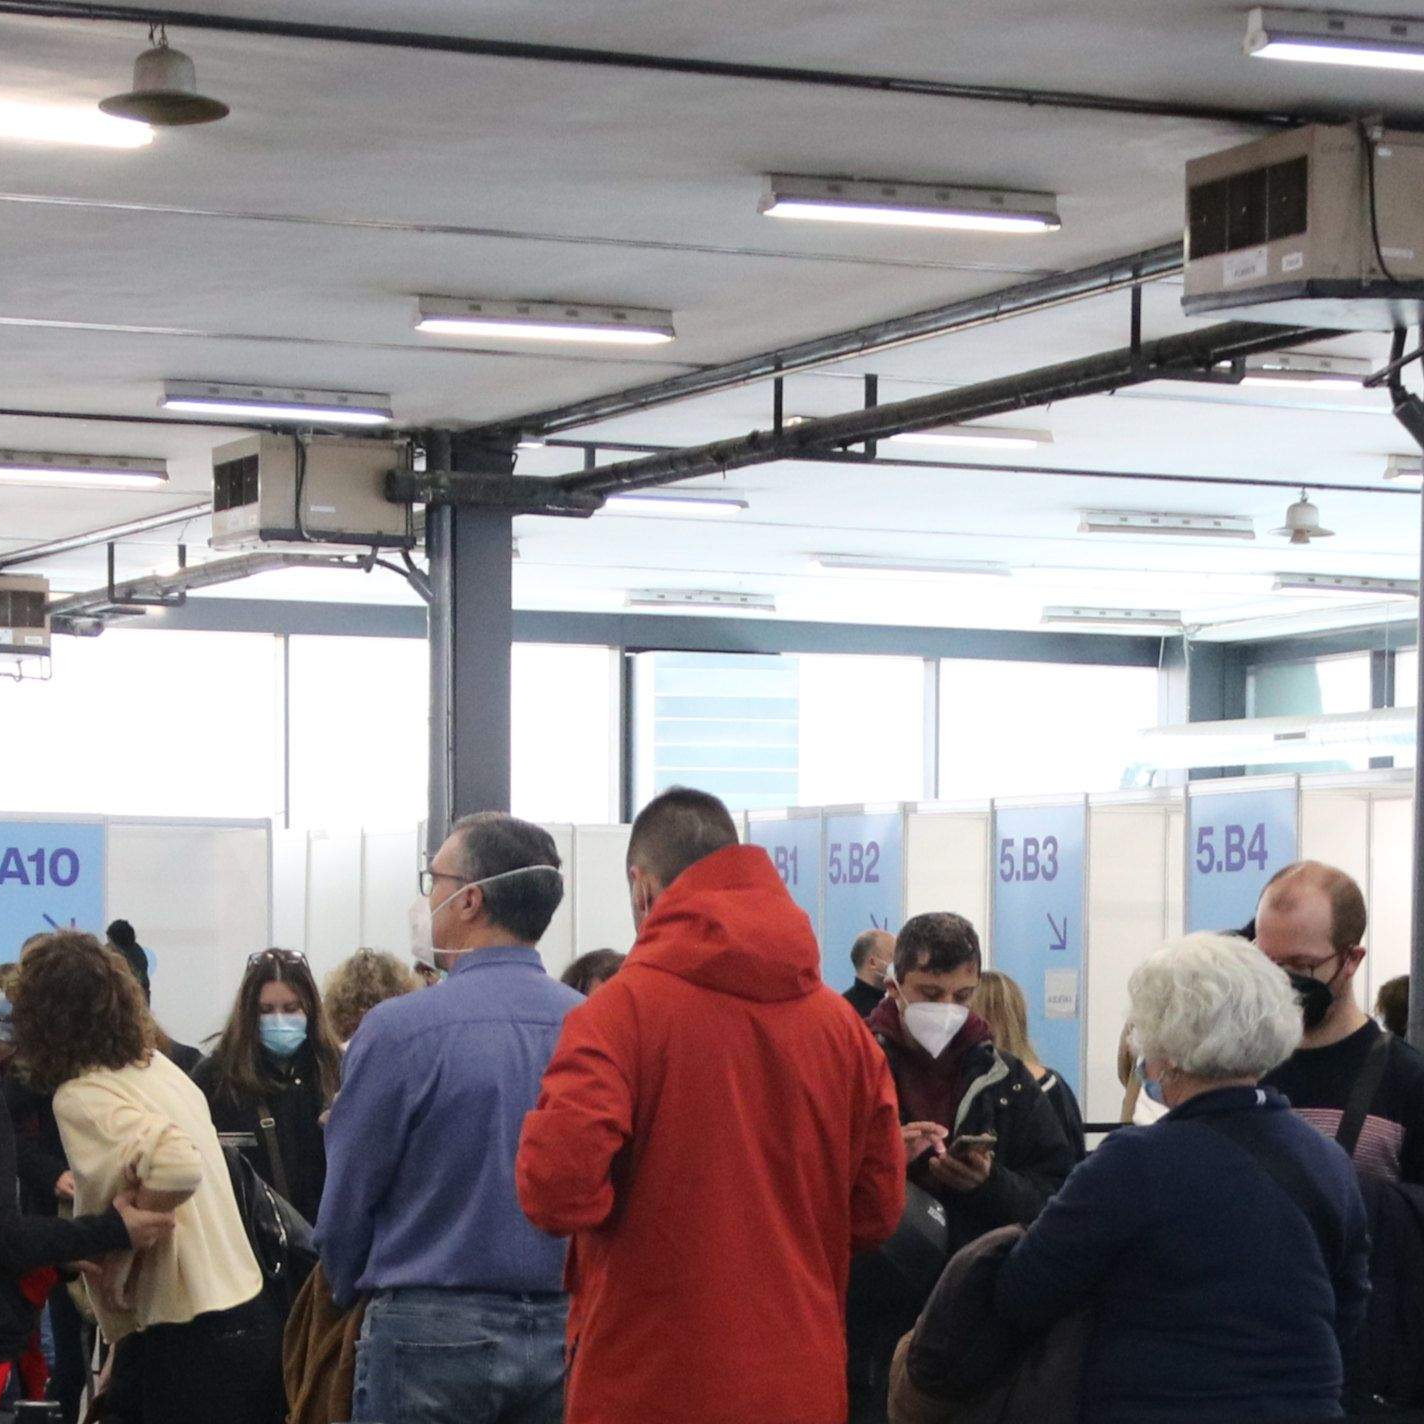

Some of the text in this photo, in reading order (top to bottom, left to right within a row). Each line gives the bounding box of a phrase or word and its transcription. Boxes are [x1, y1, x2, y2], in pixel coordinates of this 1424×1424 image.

[829, 842, 880, 885] 5.B2
[1000, 836, 1058, 881] 5.B3
[1196, 825, 1267, 873] 5.B4
